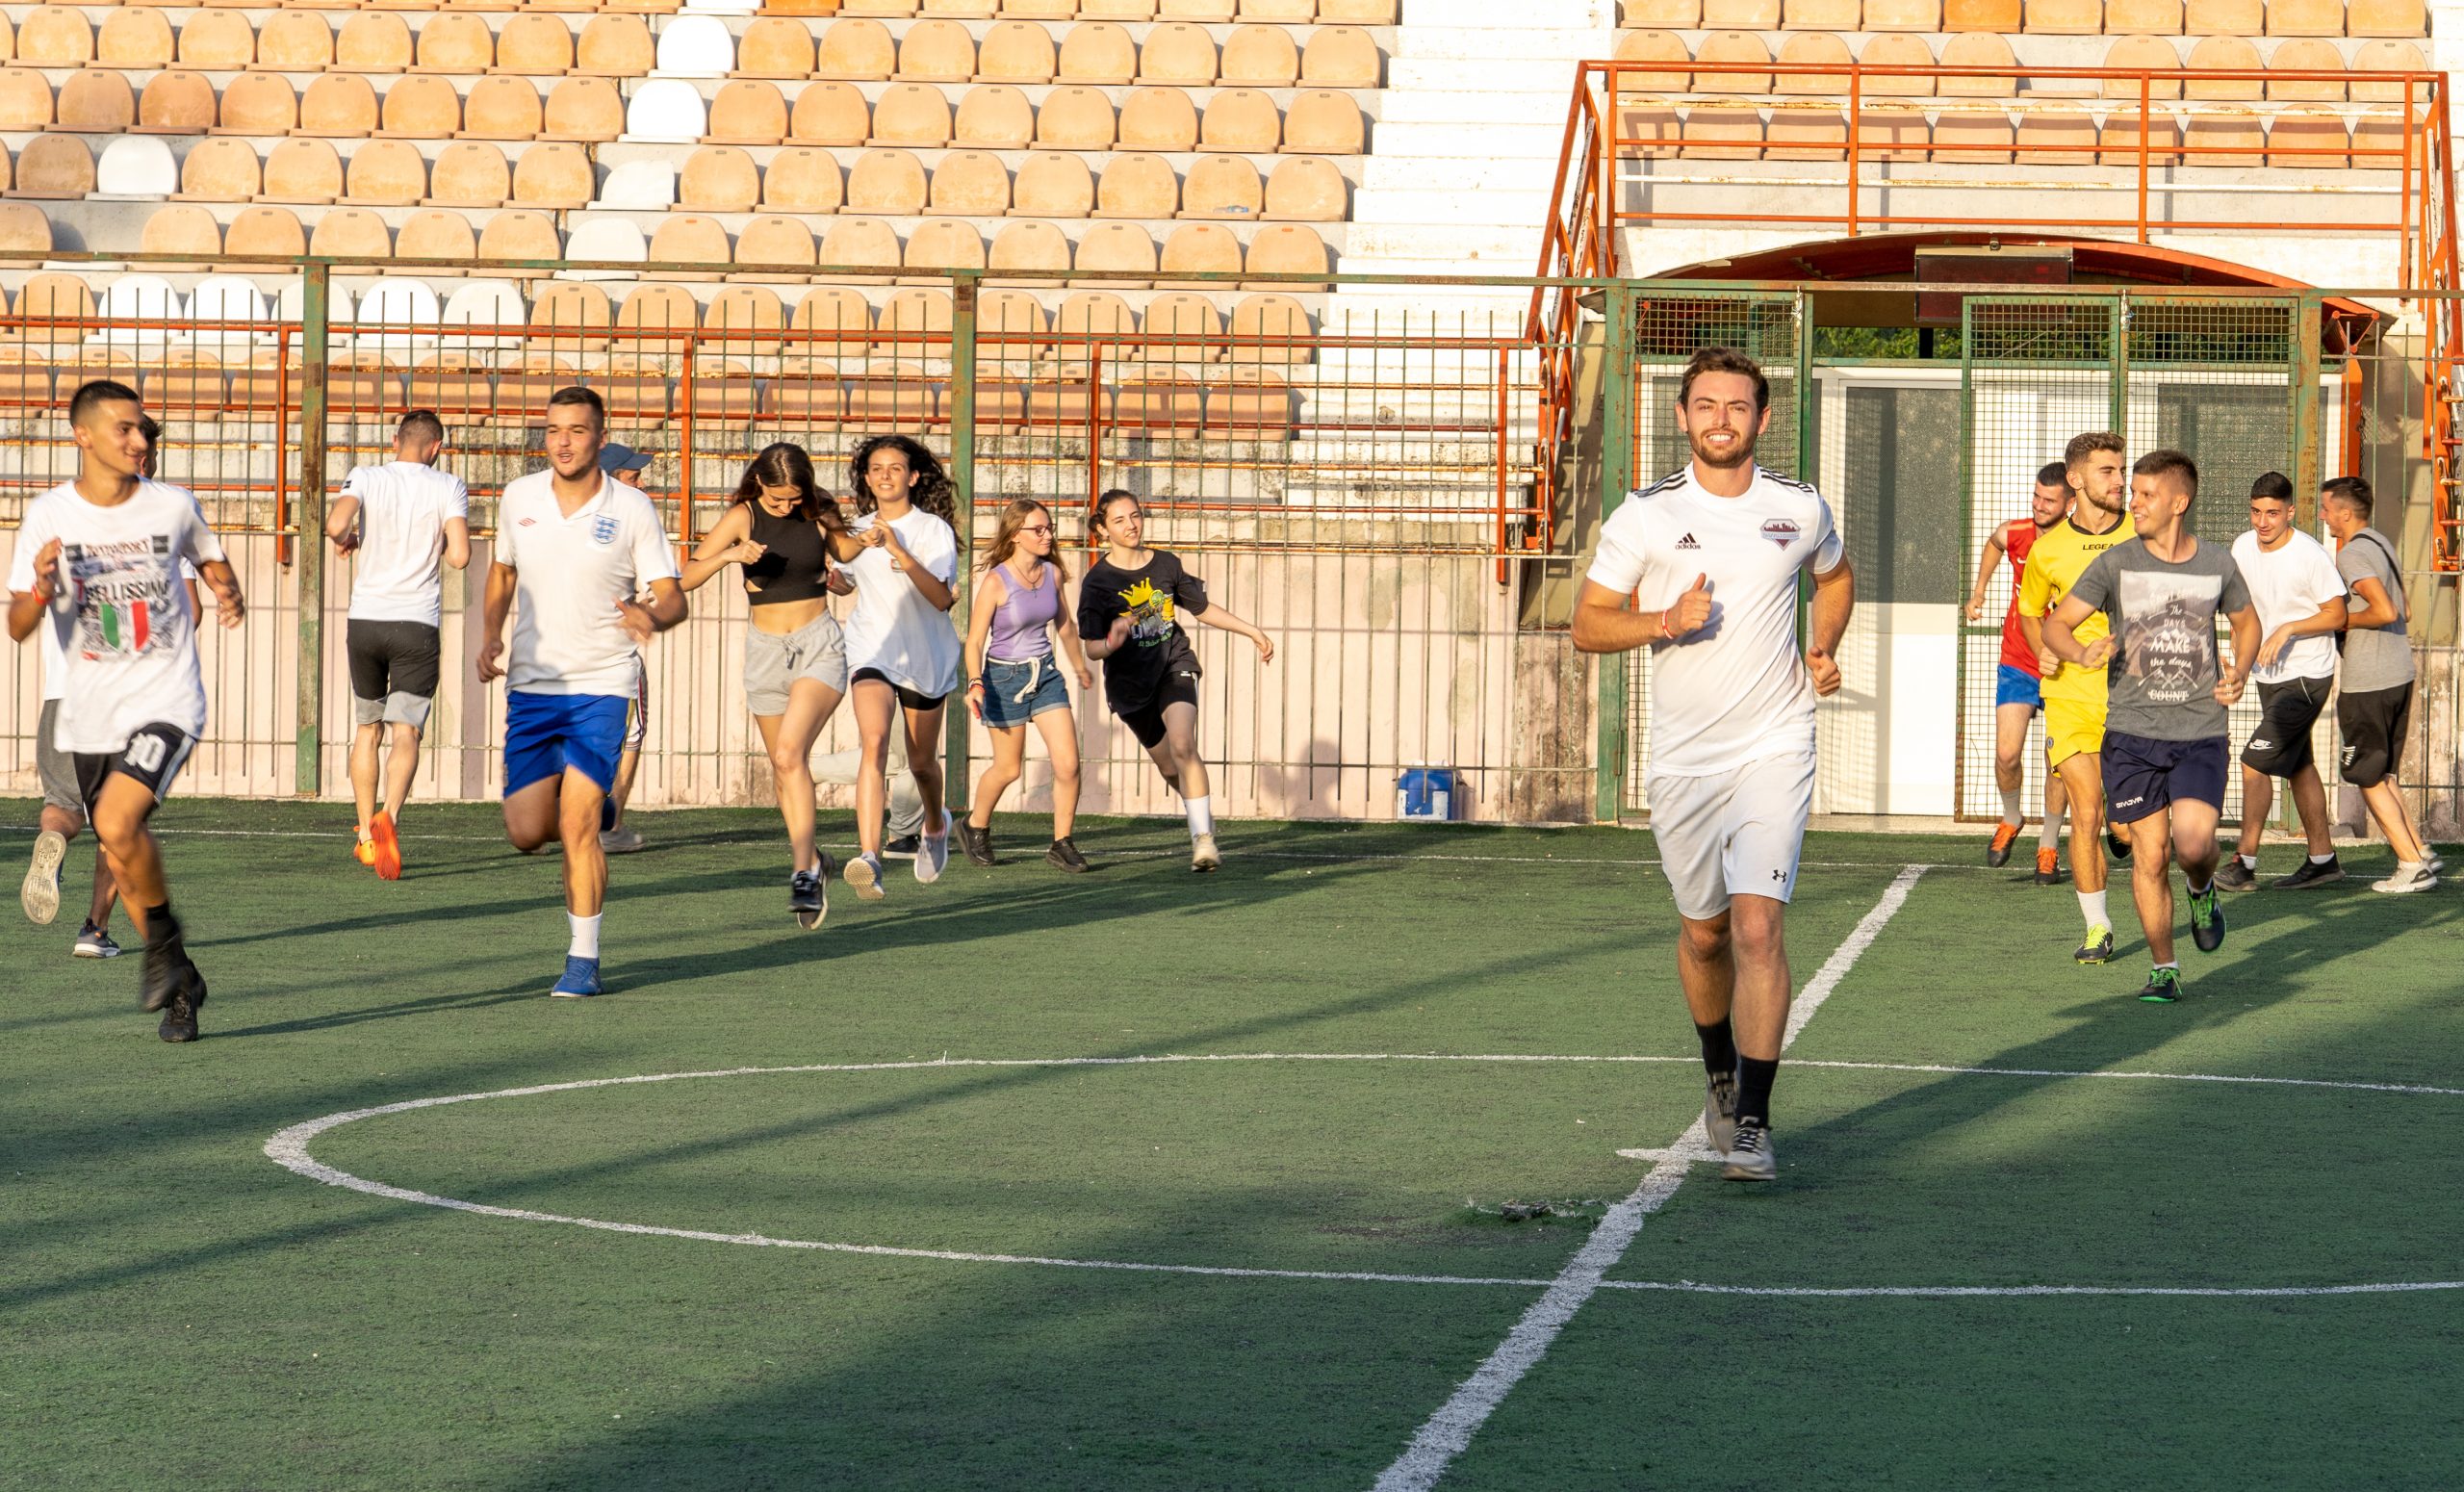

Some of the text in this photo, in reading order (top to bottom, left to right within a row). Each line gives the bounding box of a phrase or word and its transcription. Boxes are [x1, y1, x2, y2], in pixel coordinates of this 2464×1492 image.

[2164, 619, 2186, 629] DAYS
[2149, 637, 2191, 654] MAKE
[2150, 657, 2166, 667] the
[2147, 689, 2190, 702] COUNT
